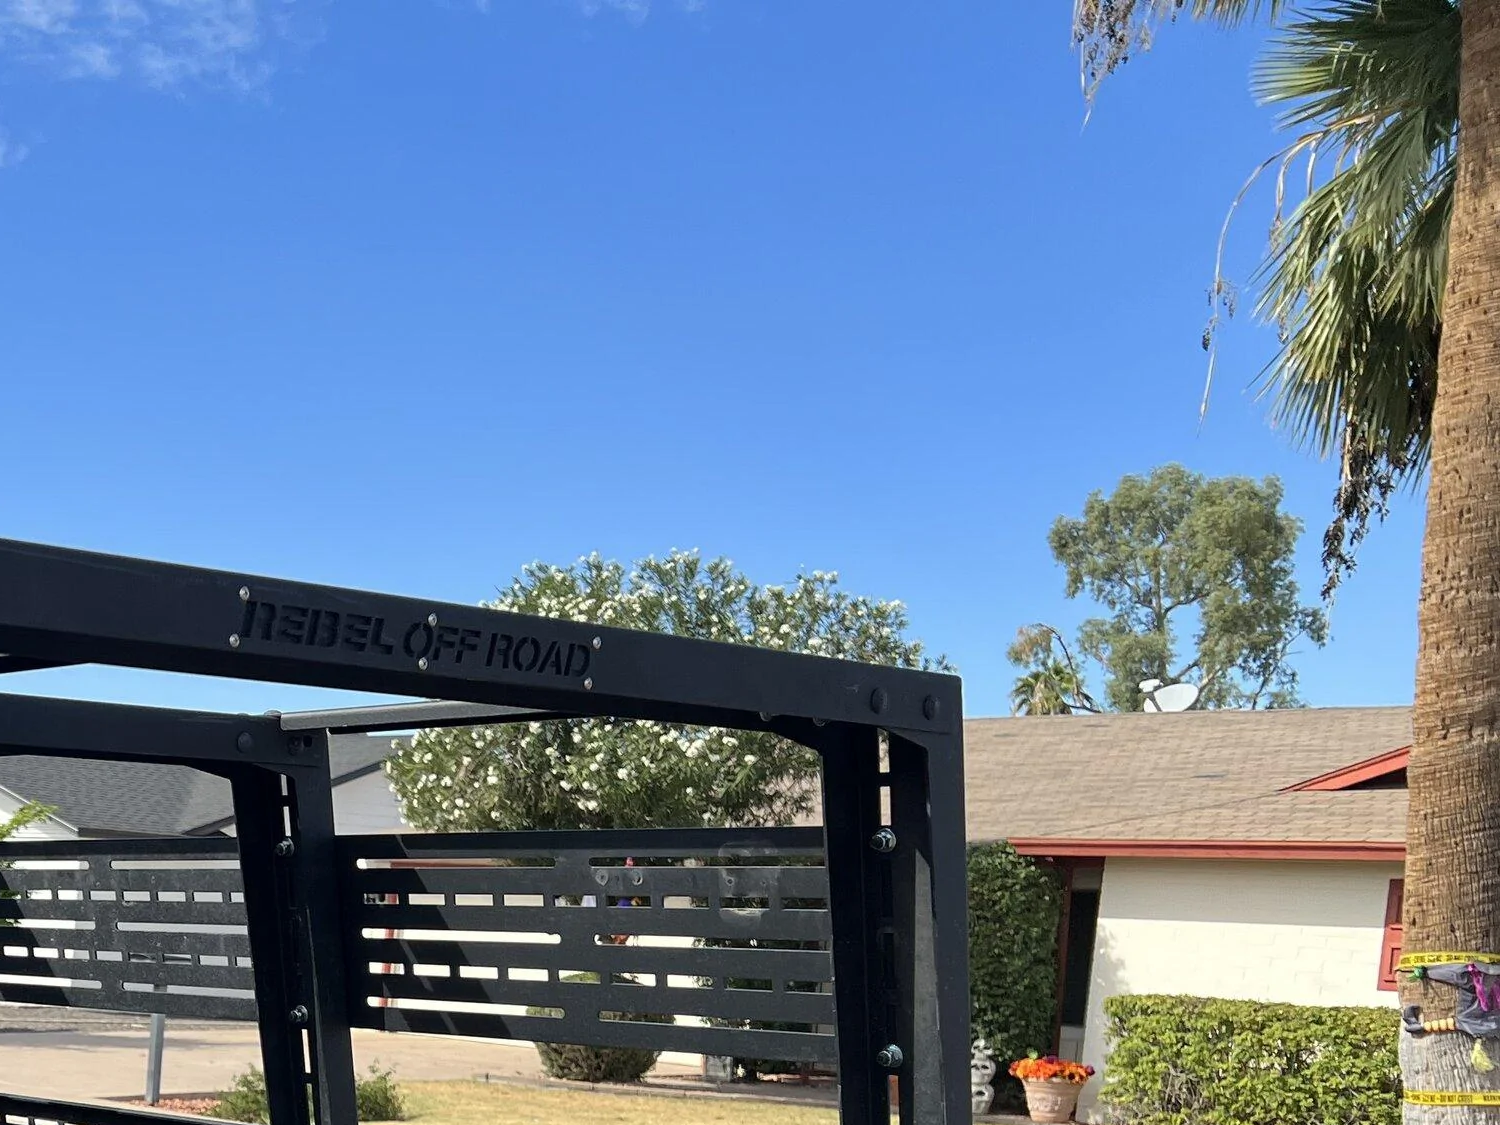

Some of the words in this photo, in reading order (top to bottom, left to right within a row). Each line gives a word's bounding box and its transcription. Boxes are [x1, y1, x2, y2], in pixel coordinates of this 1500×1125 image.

[239, 600, 395, 656] REBEL
[403, 621, 484, 664] OFF
[486, 632, 591, 678] ROAD
